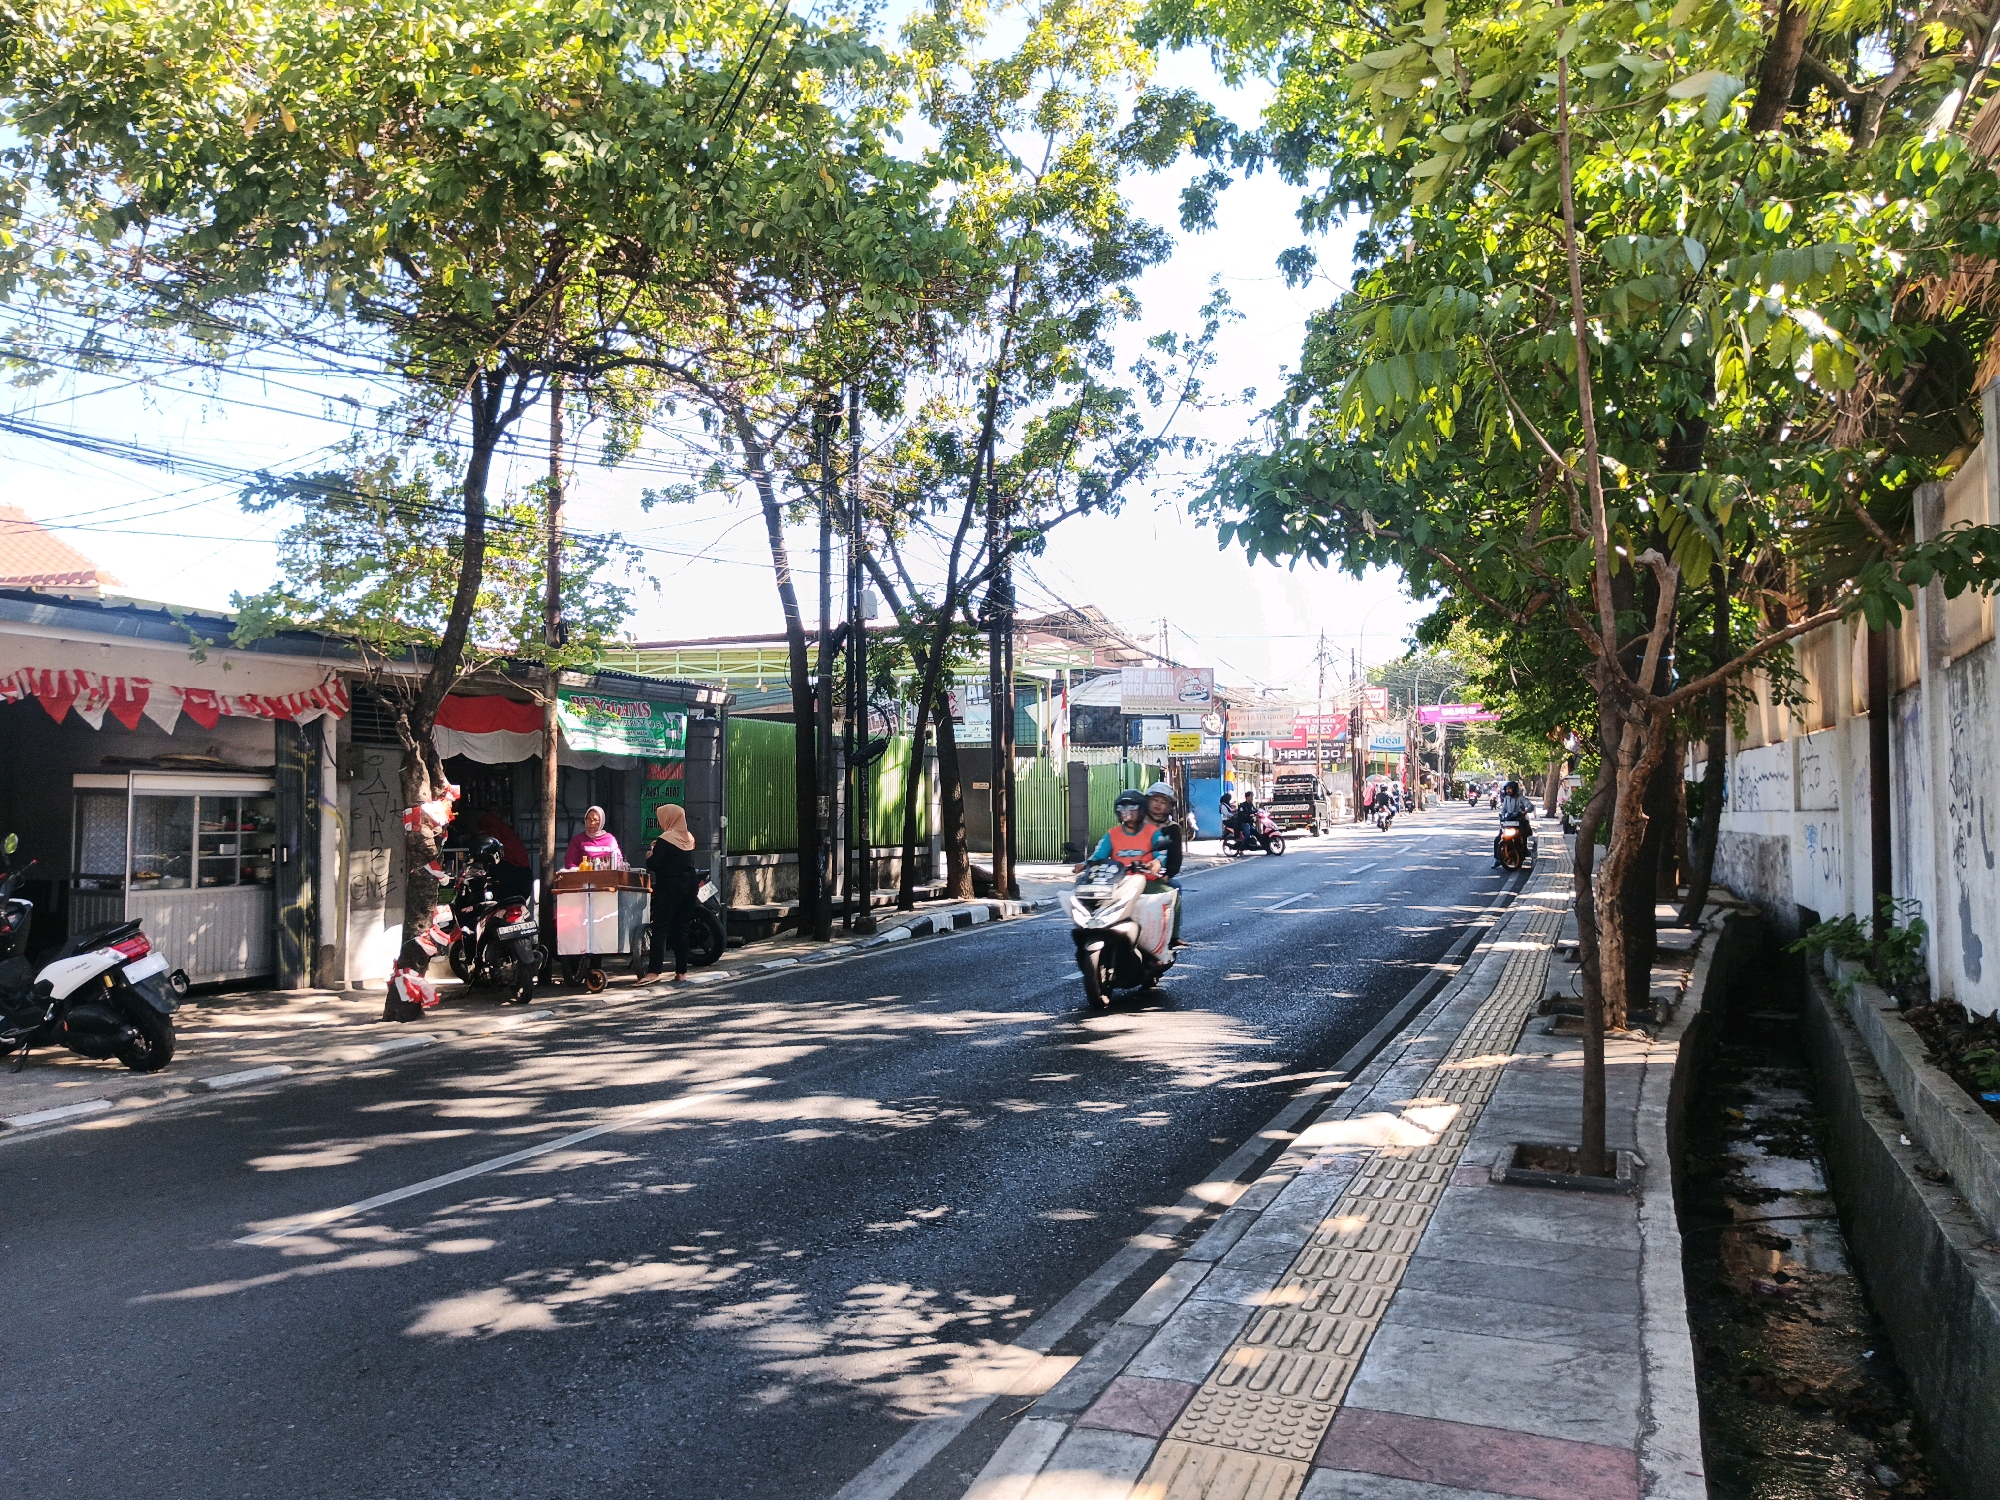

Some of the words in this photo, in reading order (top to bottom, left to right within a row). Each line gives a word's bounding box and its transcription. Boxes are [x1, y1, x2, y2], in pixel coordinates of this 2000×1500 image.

[1122, 671, 1143, 683] CUCI
[1147, 671, 1174, 684] MOBIL
[1122, 684, 1142, 696] CUCI
[1144, 684, 1174, 696] MOTOR
[1375, 736, 1401, 745] ideal
[1278, 749, 1341, 760] HAPKDO
[645, 786, 660, 798] ALAT
[665, 786, 681, 798] ALAT
